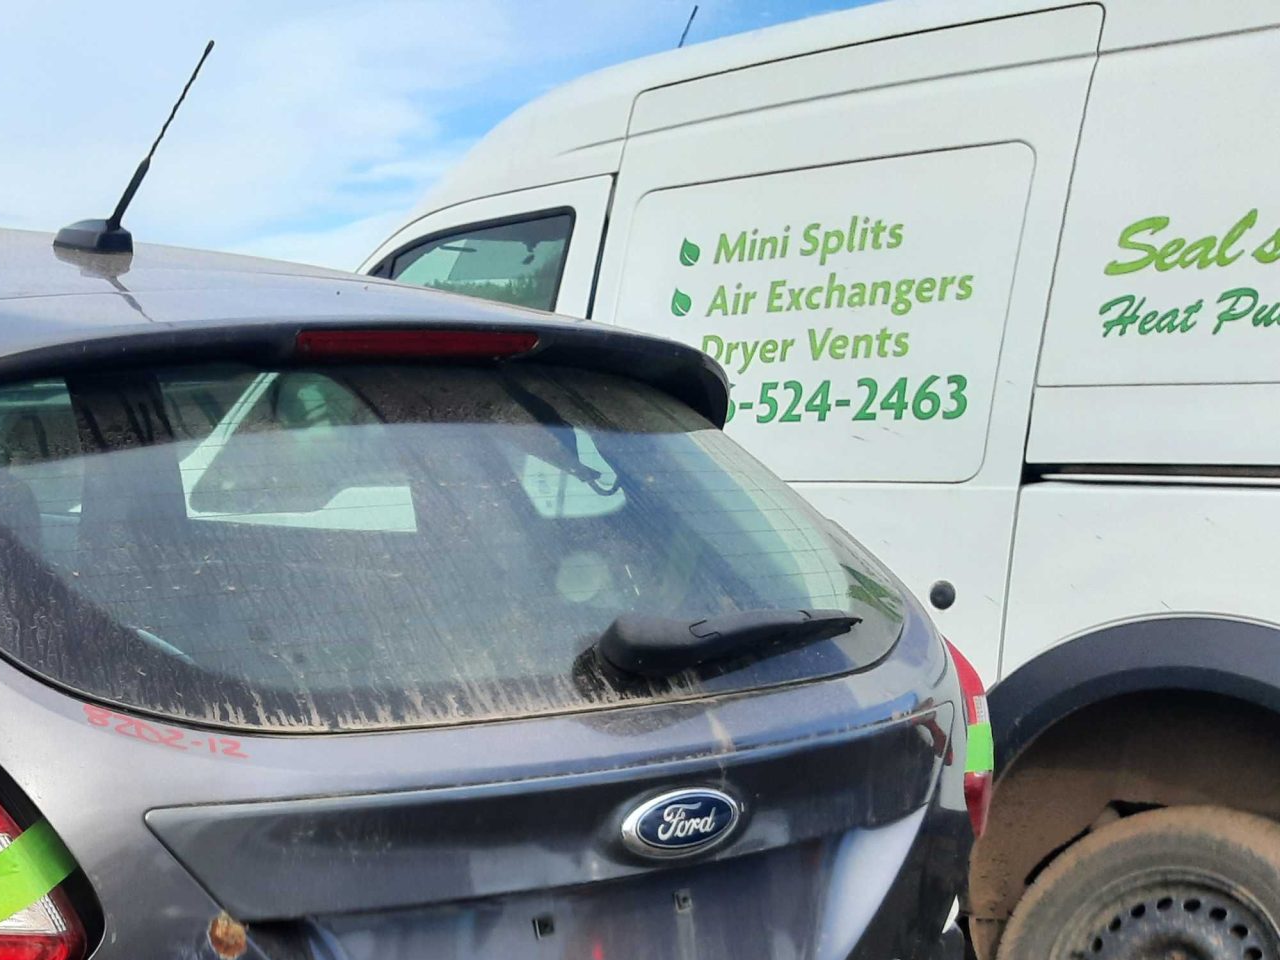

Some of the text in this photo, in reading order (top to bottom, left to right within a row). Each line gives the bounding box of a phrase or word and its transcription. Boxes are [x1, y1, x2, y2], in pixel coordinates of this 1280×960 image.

[713, 215, 904, 266] Mini Splits
[705, 272, 974, 317] Air Exchangers
[1099, 287, 1280, 338] Heat Pu
[701, 327, 910, 375] Dryer Vents
[657, 802, 717, 841] Ford
